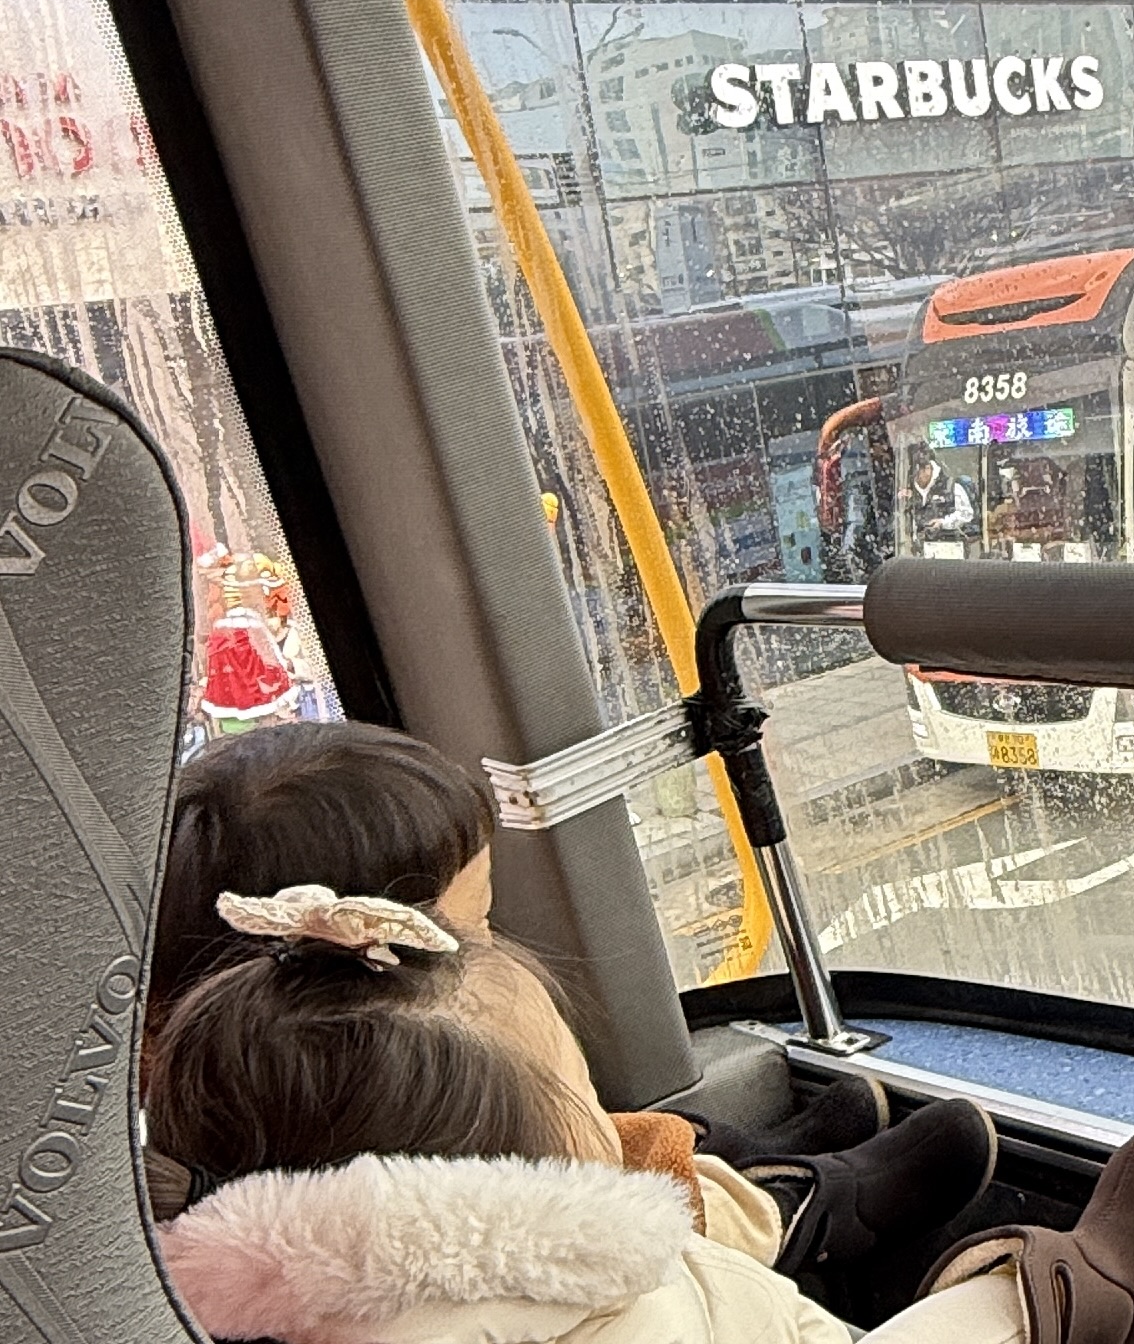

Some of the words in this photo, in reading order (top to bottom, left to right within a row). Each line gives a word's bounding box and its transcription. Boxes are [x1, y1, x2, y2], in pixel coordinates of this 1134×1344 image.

[710, 55, 1103, 128] STARBUCKS
[964, 372, 1027, 404] 8358
[0, 955, 138, 1254] VOLVO
